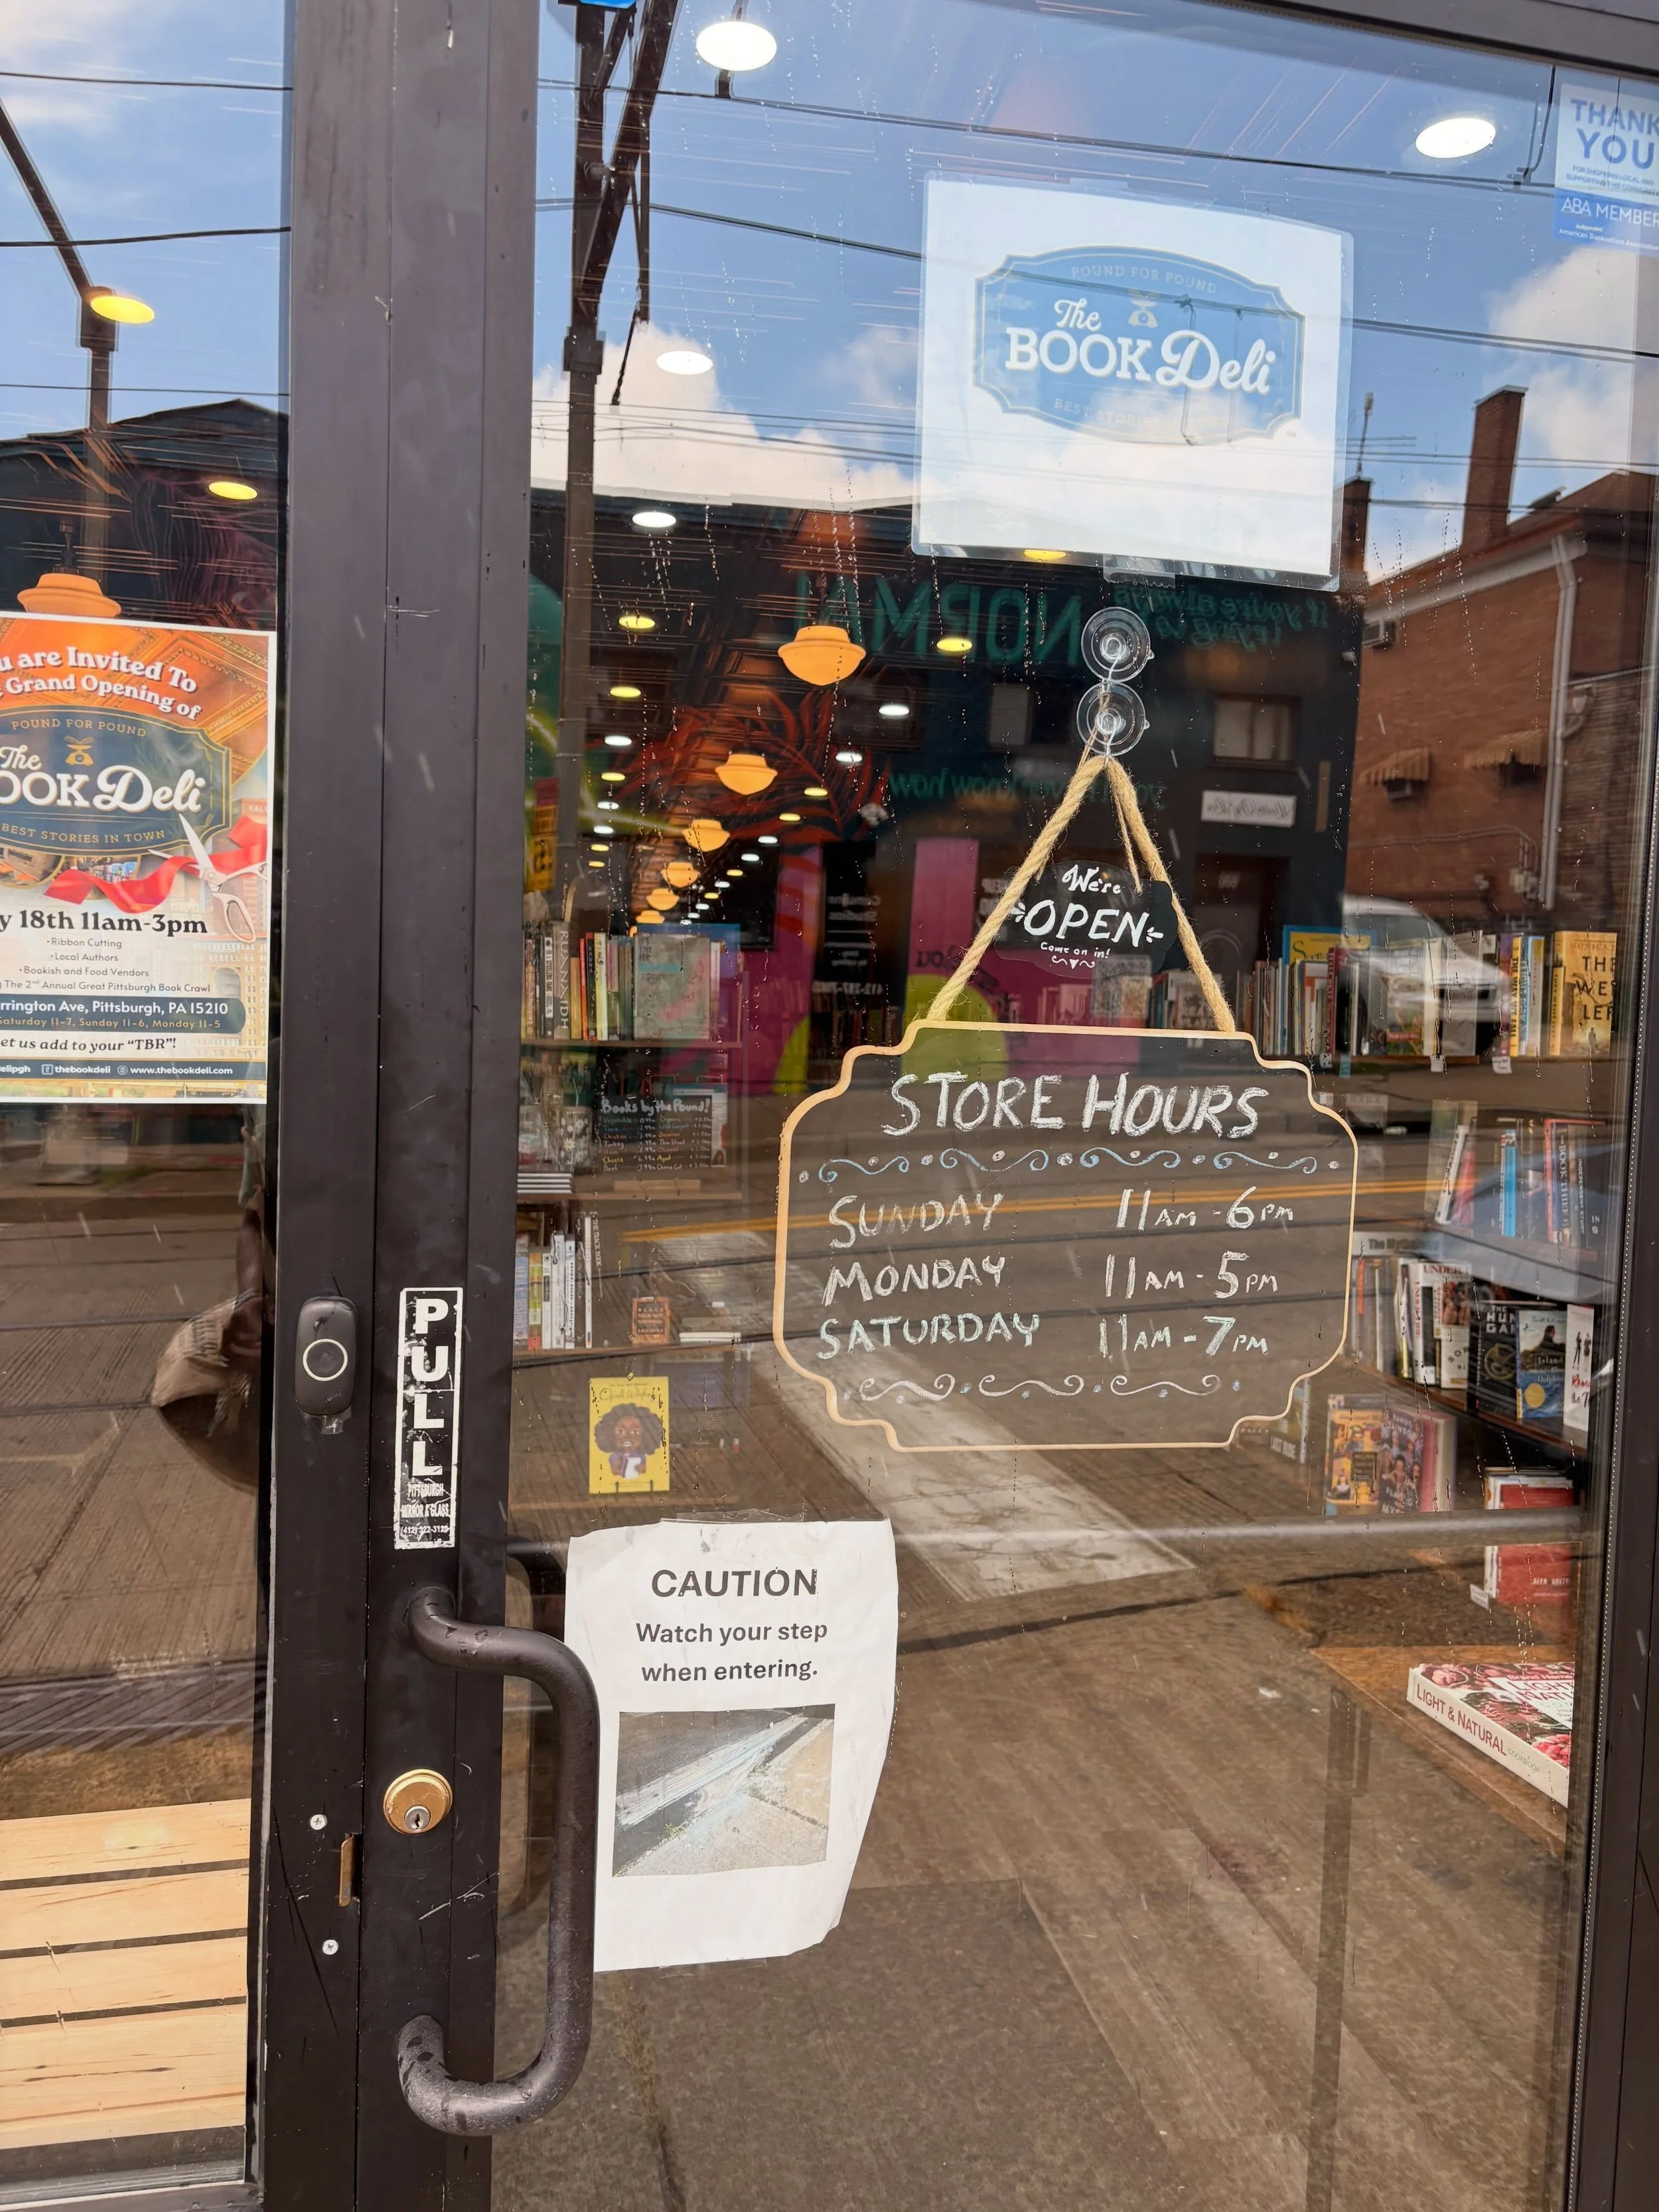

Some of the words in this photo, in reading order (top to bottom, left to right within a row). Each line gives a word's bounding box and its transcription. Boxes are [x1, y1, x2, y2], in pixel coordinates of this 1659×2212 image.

[1571, 98, 1659, 136] THANK
[1577, 127, 1654, 170] YOU
[1561, 196, 1592, 217] ABA
[1595, 201, 1659, 228] MEMBER
[1559, 228, 1588, 238] American
[1589, 232, 1625, 246] Booksellers
[1071, 265, 1125, 279] POUND
[1131, 266, 1159, 281] FOR
[1165, 272, 1218, 294] POUND
[1054, 297, 1102, 331] The
[1005, 327, 1153, 382] BOOK
[1155, 329, 1276, 395] Deli
[1054, 398, 1090, 417] BEST
[1097, 409, 1159, 428] STORIES
[18, 652, 62, 668] are
[66, 646, 163, 681] Invited
[169, 666, 197, 693] To
[5, 674, 77, 695] Grand
[81, 675, 175, 713] Opening
[176, 705, 202, 720] of
[11, 718, 61, 730] POUND
[66, 719, 93, 729] FOR
[98, 721, 147, 737] POUND
[0, 745, 42, 771] The
[0, 770, 92, 808] OOK
[93, 765, 206, 812] Deli
[2, 823, 36, 838] BEST
[41, 830, 100, 844] STORIES
[104, 834, 119, 843] IN
[124, 830, 166, 842] TOWN
[19, 910, 75, 930] 18th
[81, 911, 208, 937] 11am-3pm
[1023, 899, 1150, 948] OPEN
[51, 937, 85, 946] Ribbon
[88, 938, 122, 950] Cutting
[1041, 942, 1070, 954] Come
[1094, 948, 1112, 960] in!
[55, 952, 80, 961] Local
[82, 953, 119, 962] Authors
[1581, 955, 1616, 973] THE
[24, 966, 61, 975] Bookish
[85, 967, 108, 976] Food
[110, 968, 149, 977] Vendors
[560, 930, 569, 1029] RUANAIDH
[5, 980, 23, 988] The
[42, 981, 76, 990] Annual
[78, 982, 106, 990] Great
[108, 982, 156, 993] Pittsburgh
[184, 984, 210, 992] Crawl
[1575, 980, 1608, 997] WE
[0, 999, 56, 1014] rrington
[58, 1000, 89, 1014] Ave,
[92, 1000, 165, 1016] Pittsburgh,
[169, 1001, 187, 1014] PA
[190, 1002, 228, 1015] 15210
[1583, 1003, 1613, 1021] LEF
[0, 1017, 46, 1027] Saturday
[50, 1017, 76, 1027] 11-7,
[79, 1018, 119, 1029] Sunday
[123, 1019, 149, 1028] 11-6,
[153, 1019, 195, 1029] Monday
[199, 1019, 221, 1028] 11-5
[1, 1038, 16, 1047] et
[19, 1039, 36, 1049] us
[40, 1039, 68, 1050] add
[72, 1041, 87, 1051] to
[89, 1042, 124, 1054] your
[0, 1065, 31, 1074] elipgh
[54, 1065, 111, 1074] thebookdeli
[129, 1066, 233, 1074] www.thebookdeli.com
[601, 1096, 638, 1114] Books
[640, 1098, 654, 1116] by
[655, 1098, 672, 1113] the
[672, 1098, 711, 1114] Pound!
[881, 1071, 1066, 1138] STORE
[1080, 1072, 1269, 1140] HOURS
[603, 1140, 625, 1149] Turkey
[1559, 1144, 1567, 1179] BOOK
[828, 1192, 1005, 1250] SUNDAY
[822, 1255, 1007, 1307] MONDAY
[1486, 1312, 1516, 1322] HUN
[816, 1312, 1041, 1361] SATURDAY
[411, 1297, 449, 1477] PULL
[407, 1483, 444, 1498] PITTSBURGH
[401, 1504, 424, 1518] MIRROR
[430, 1503, 449, 1517] GLASS
[651, 1568, 818, 1597] CAUTION
[636, 1622, 713, 1643] Watch
[719, 1623, 772, 1647] your
[777, 1623, 828, 1644] step
[641, 1663, 707, 1682] when
[714, 1659, 818, 1682] entering.
[1417, 1682, 1446, 1715] LIGHT
[1448, 1708, 1455, 1722] &
[1457, 1713, 1507, 1757] NATURAL
